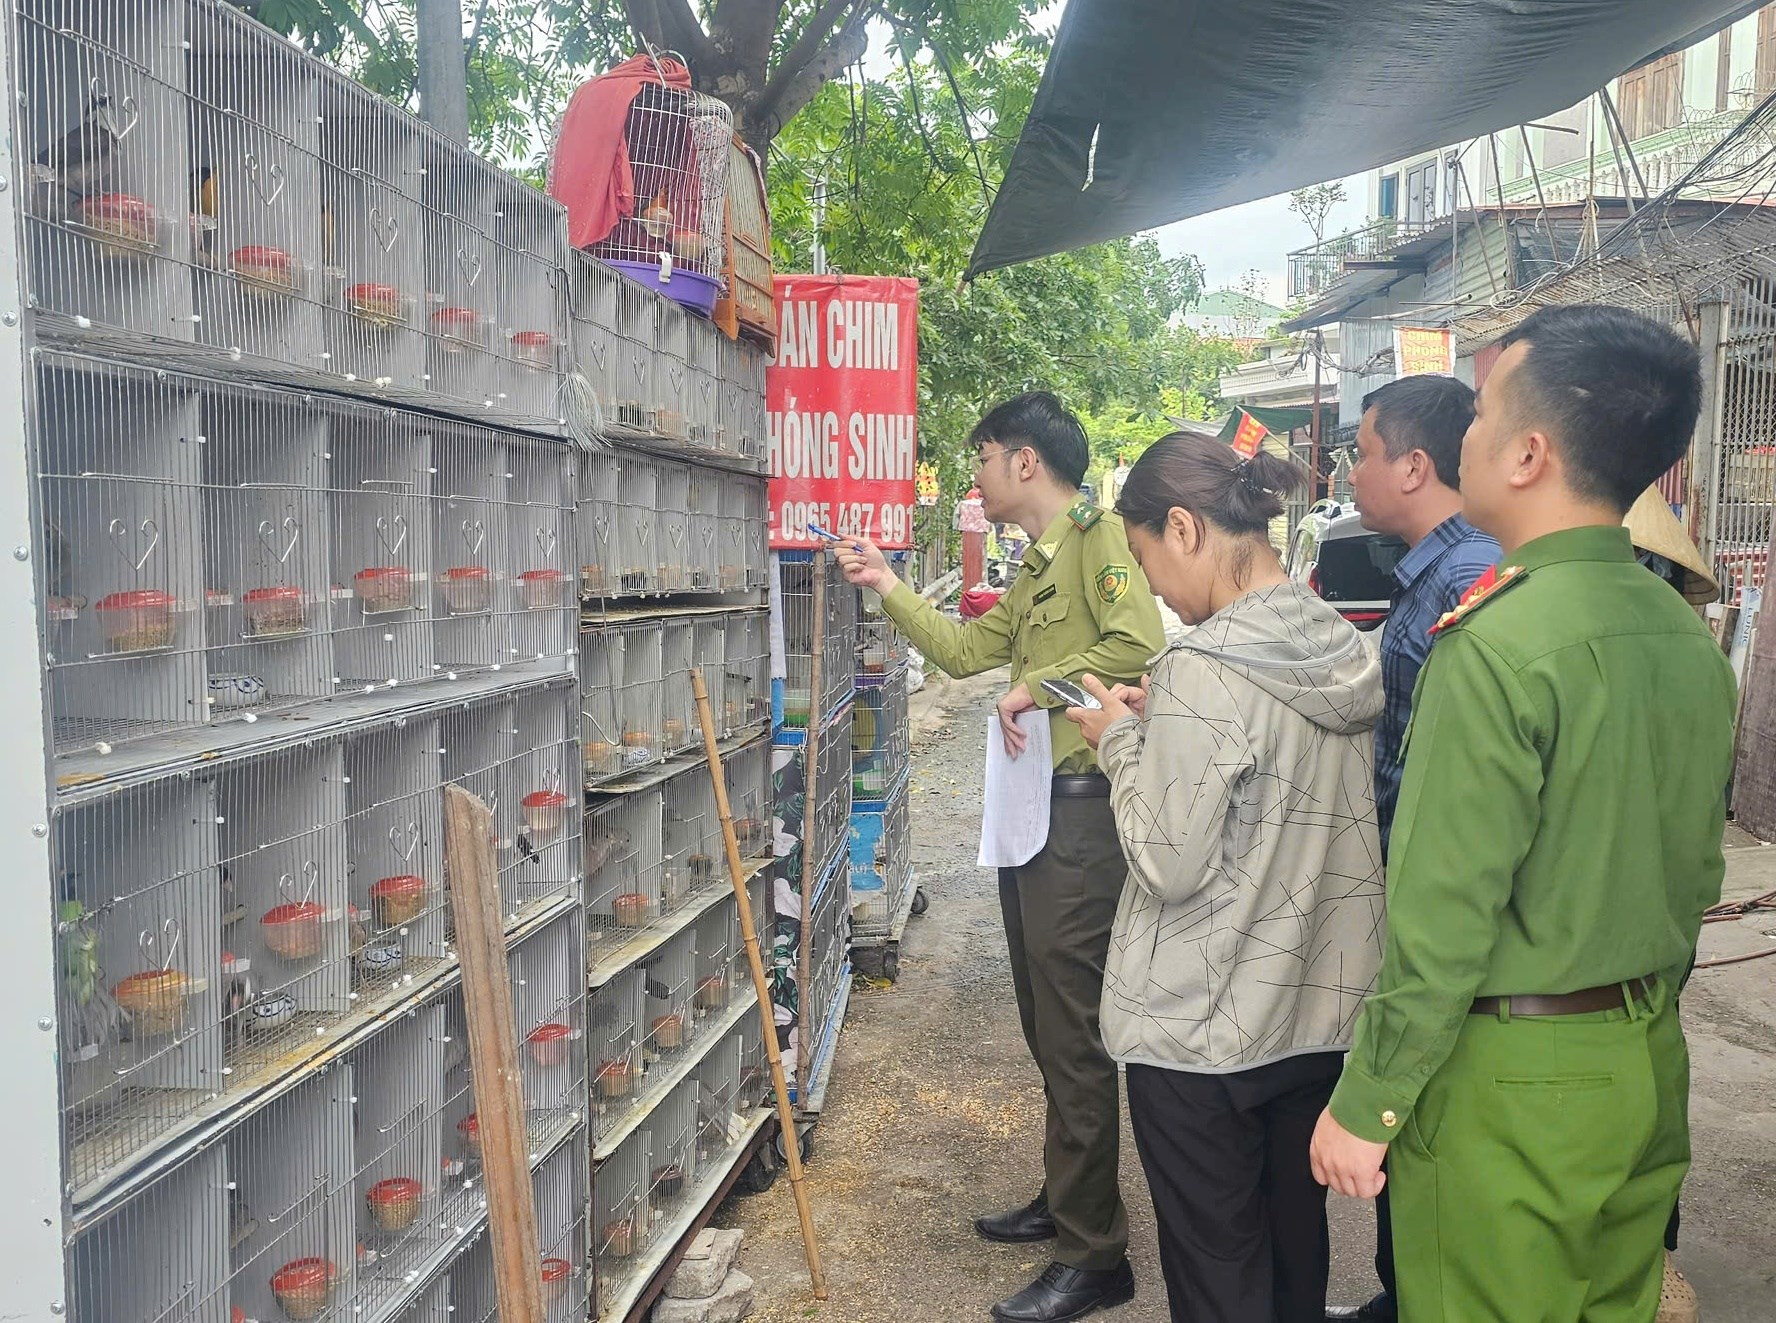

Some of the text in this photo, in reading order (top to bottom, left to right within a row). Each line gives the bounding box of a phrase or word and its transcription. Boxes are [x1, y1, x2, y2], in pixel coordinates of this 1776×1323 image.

[766, 284, 898, 370] ÁN CHIM
[766, 396, 914, 480] HÓNG SINH
[781, 500, 831, 542] 0965
[836, 502, 874, 540] 487
